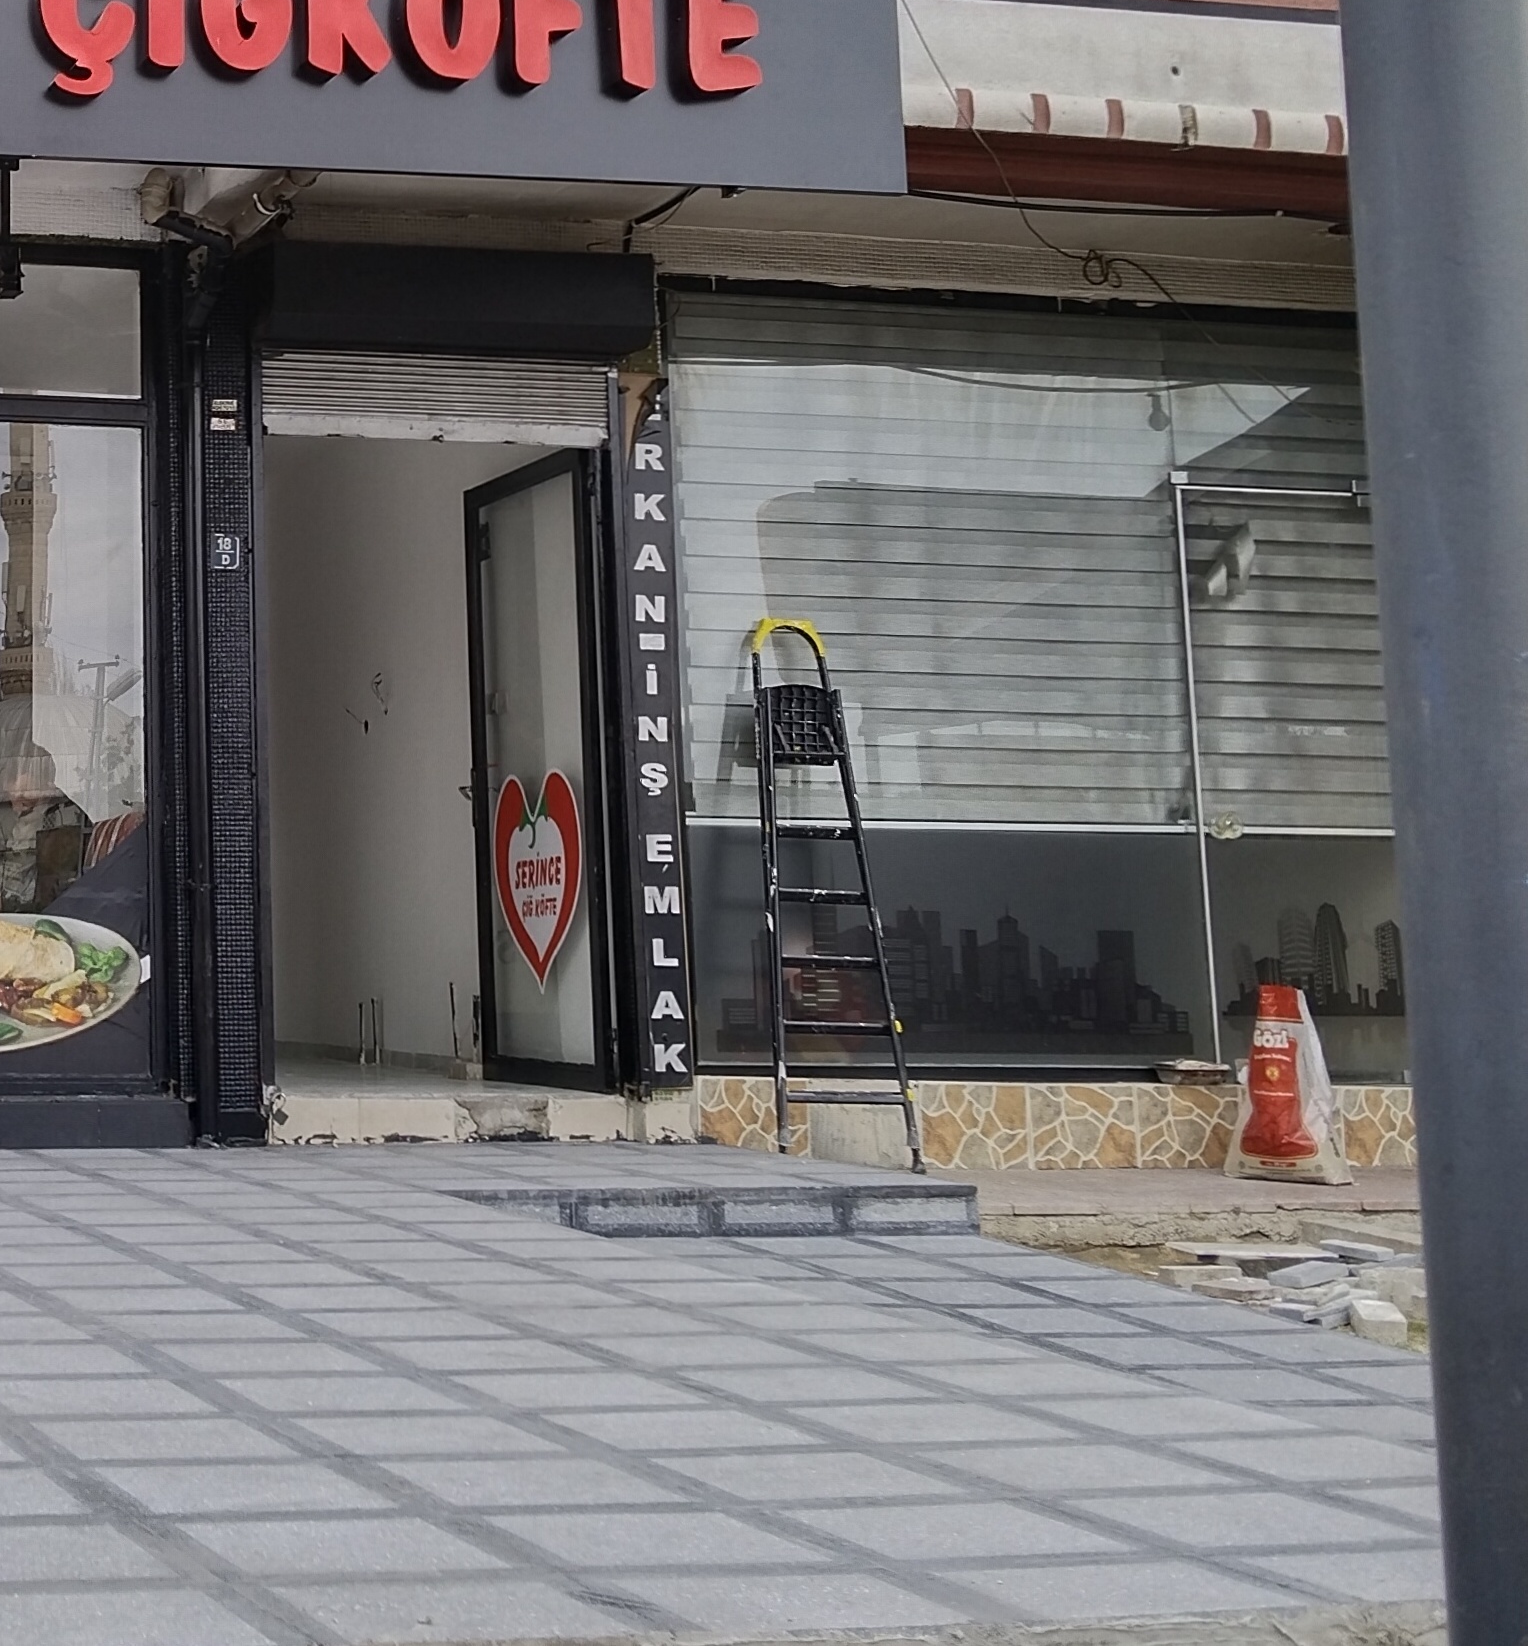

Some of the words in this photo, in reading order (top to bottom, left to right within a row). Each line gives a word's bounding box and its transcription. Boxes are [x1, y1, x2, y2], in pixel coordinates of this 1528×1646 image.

[216, 537, 232, 551] 18
[221, 554, 230, 565] D
[514, 852, 562, 891] SERİNCE
[534, 893, 558, 919] KÖFTE
[643, 833, 689, 1073] EMLAK
